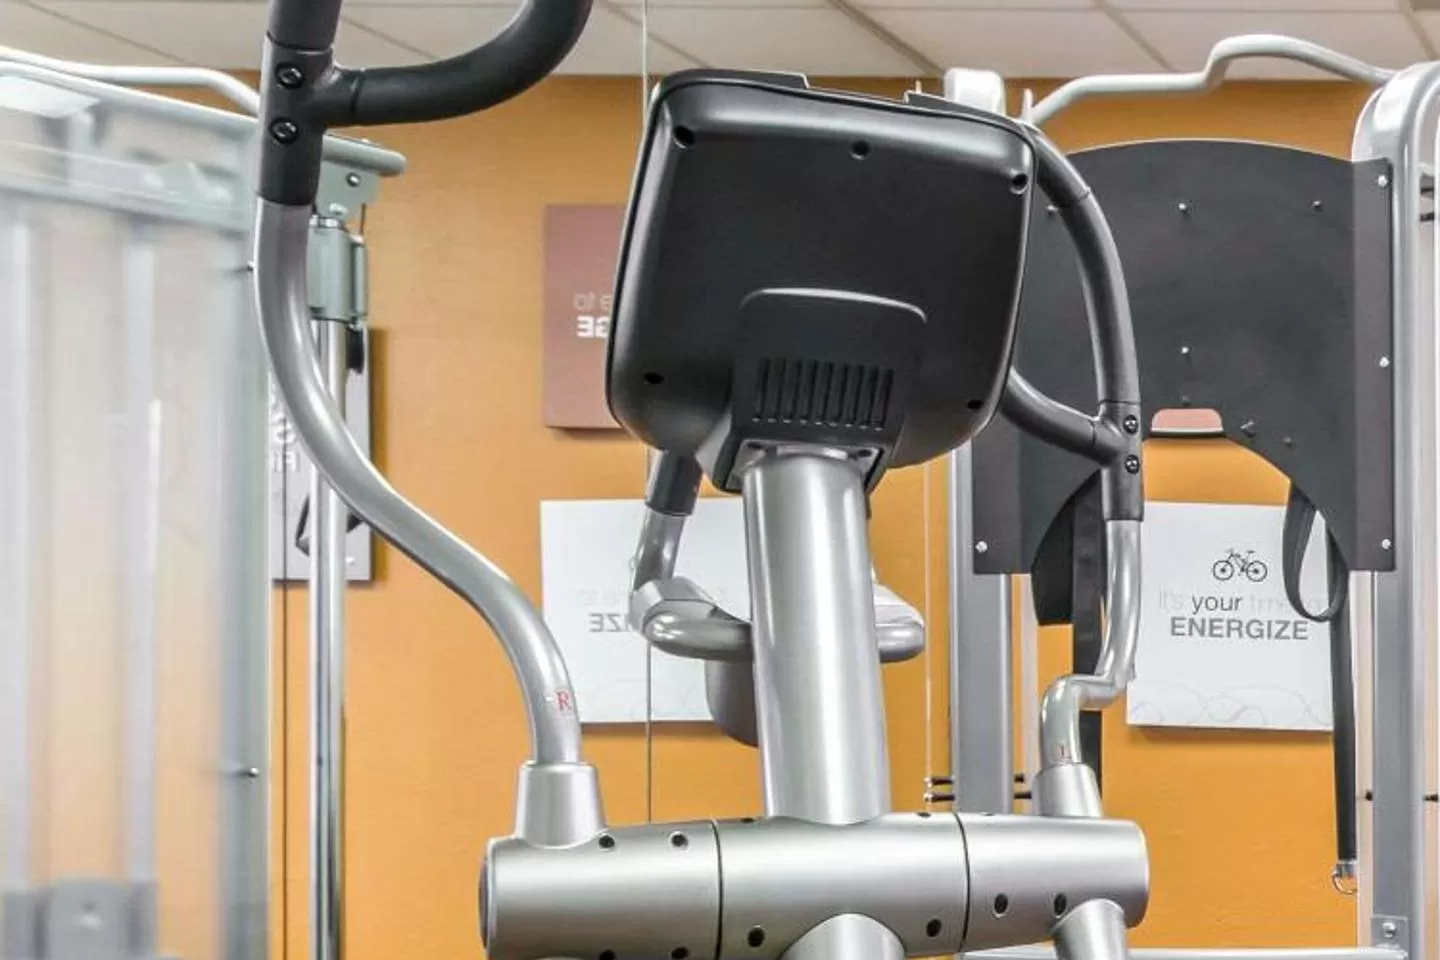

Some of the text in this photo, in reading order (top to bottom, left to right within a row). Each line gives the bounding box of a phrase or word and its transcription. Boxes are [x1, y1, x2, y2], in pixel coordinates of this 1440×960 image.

[1191, 595, 1243, 615] your
[1170, 616, 1309, 641] ENERGIZE
[557, 690, 573, 711] R
